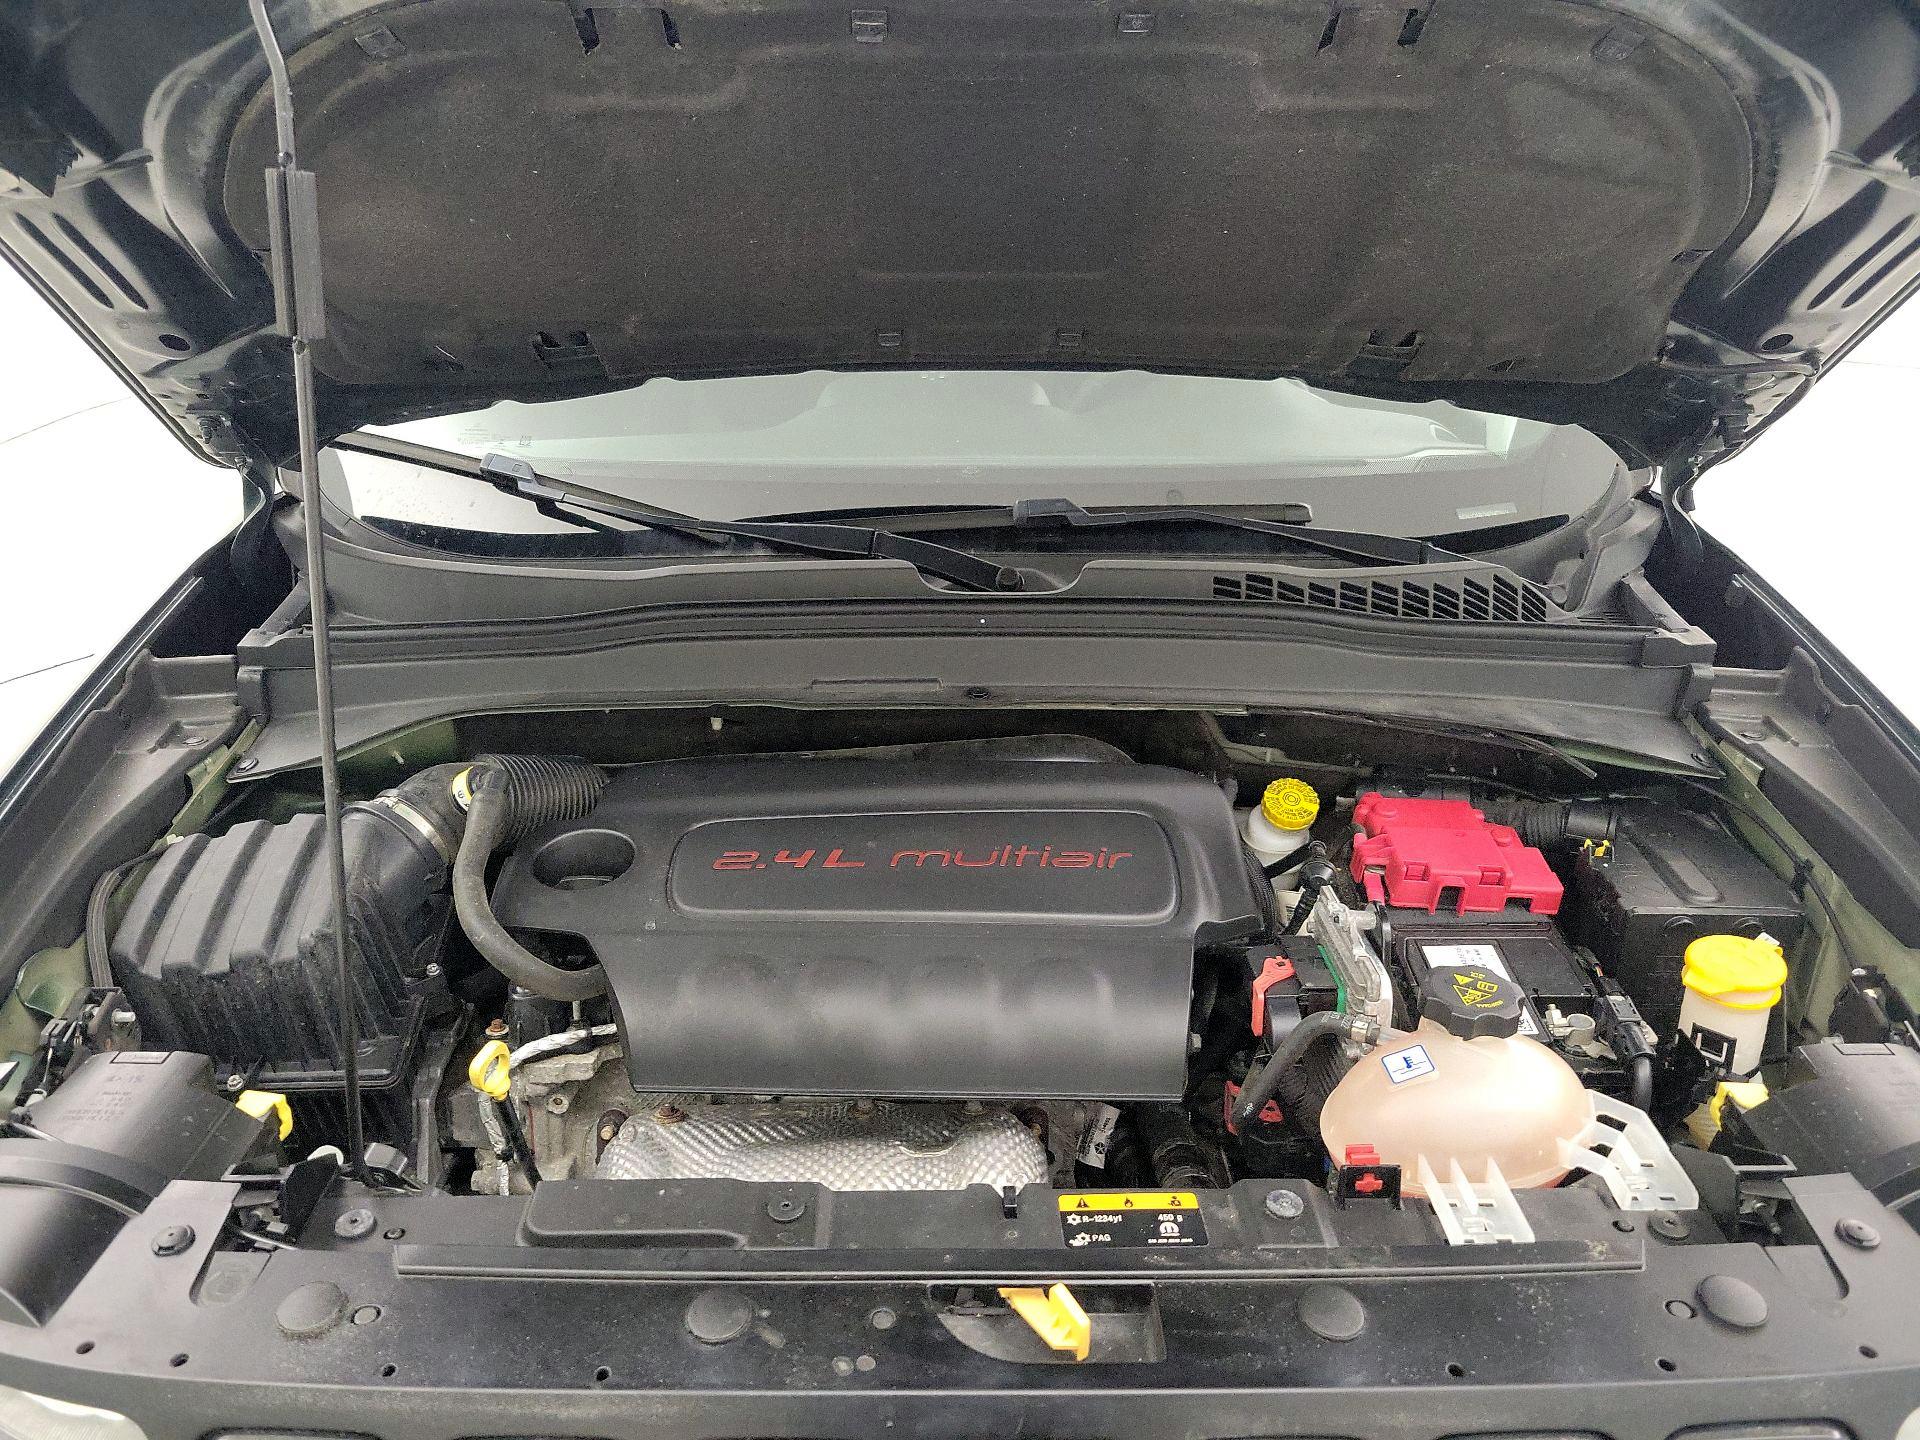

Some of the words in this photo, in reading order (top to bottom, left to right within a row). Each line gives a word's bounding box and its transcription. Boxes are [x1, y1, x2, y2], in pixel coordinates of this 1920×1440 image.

[712, 848, 865, 870] 2.4L
[889, 844, 1133, 869] multiair
[1091, 1233, 1112, 1242] PAG
